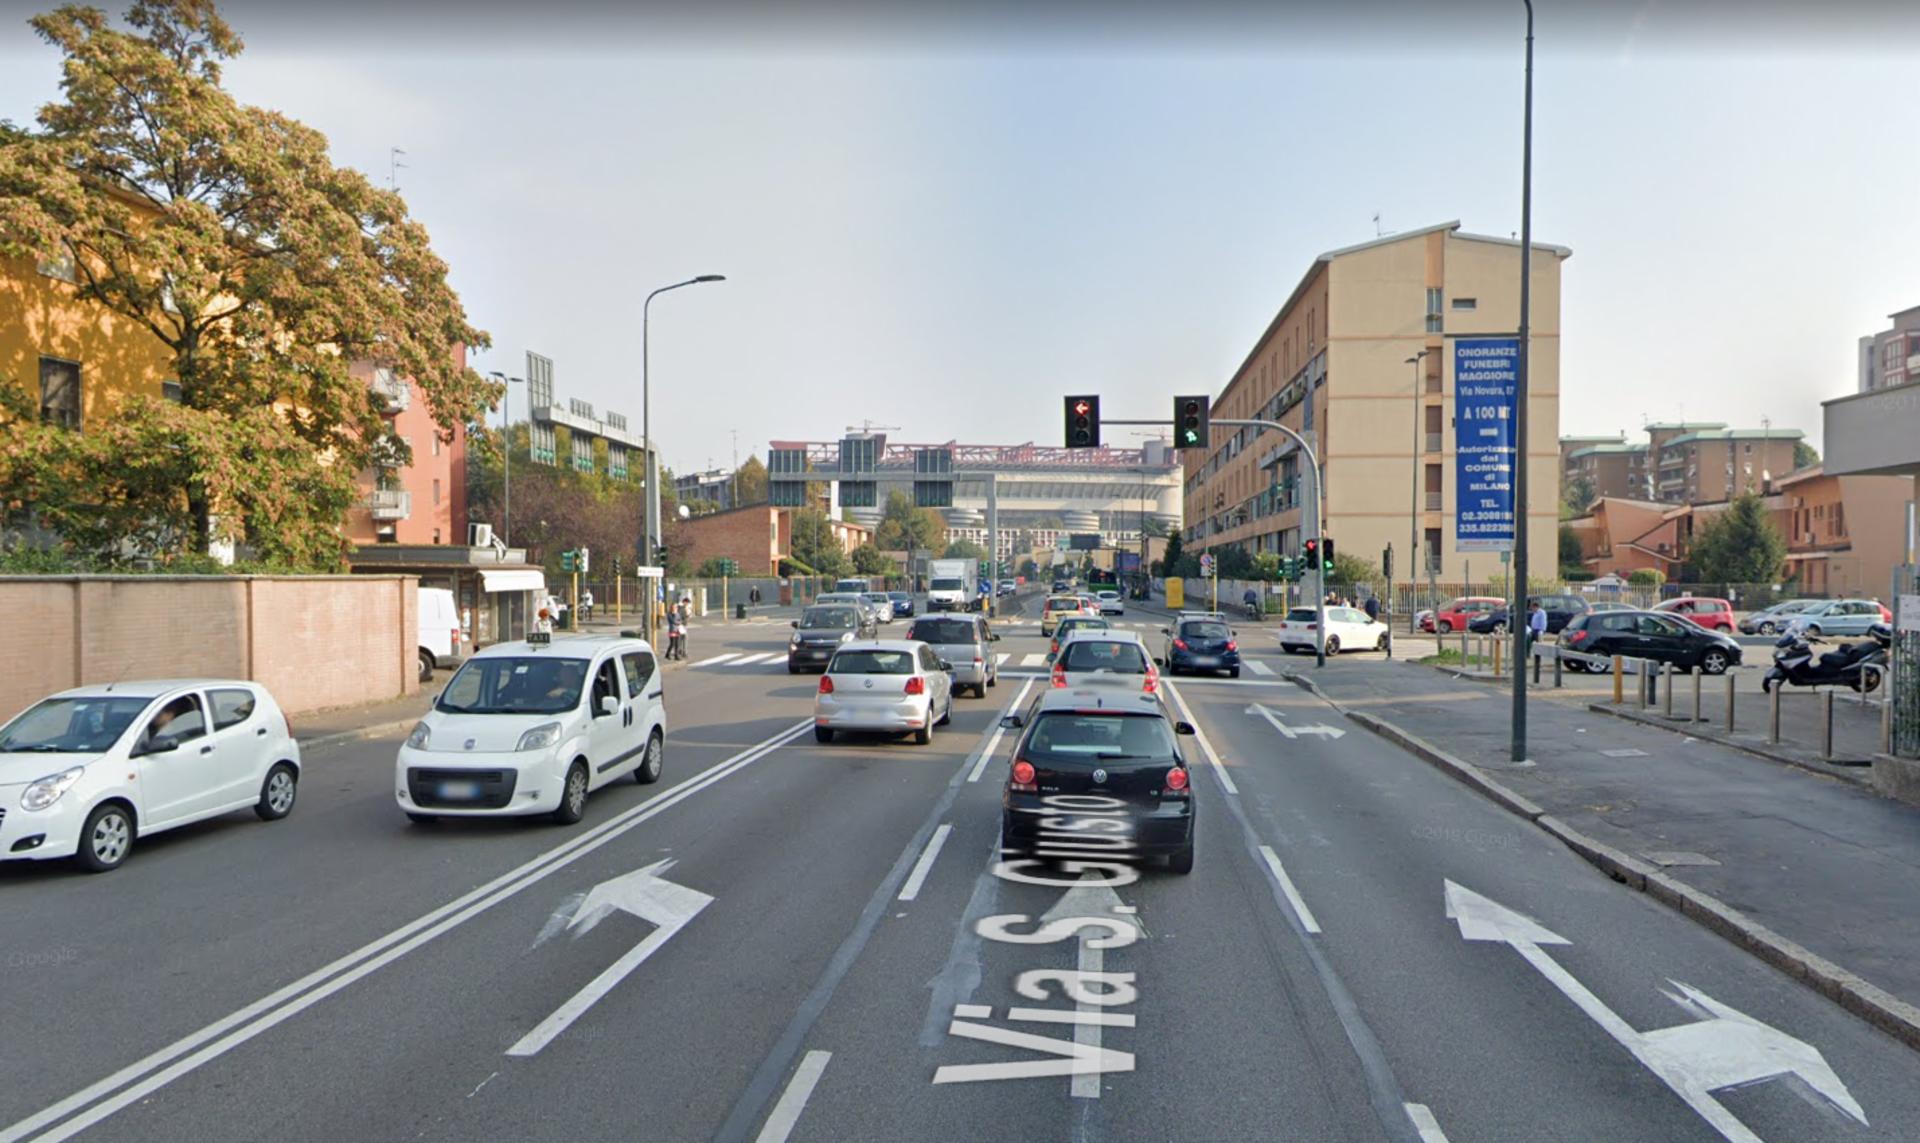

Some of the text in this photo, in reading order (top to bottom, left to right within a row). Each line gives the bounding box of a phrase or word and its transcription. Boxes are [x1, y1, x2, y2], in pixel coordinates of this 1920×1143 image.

[1458, 347, 1517, 357] ONORANZE
[1464, 359, 1511, 369] FUNEBRI
[1459, 371, 1516, 381] MAGGIORE
[1460, 386, 1473, 396] Via
[1464, 406, 1472, 419] A
[1475, 406, 1495, 419] 100
[1480, 454, 1499, 462] dal
[1465, 464, 1511, 472] COMUNE
[1484, 473, 1496, 481] di
[1469, 483, 1511, 491] MILANO
[1480, 499, 1500, 508] TEL.
